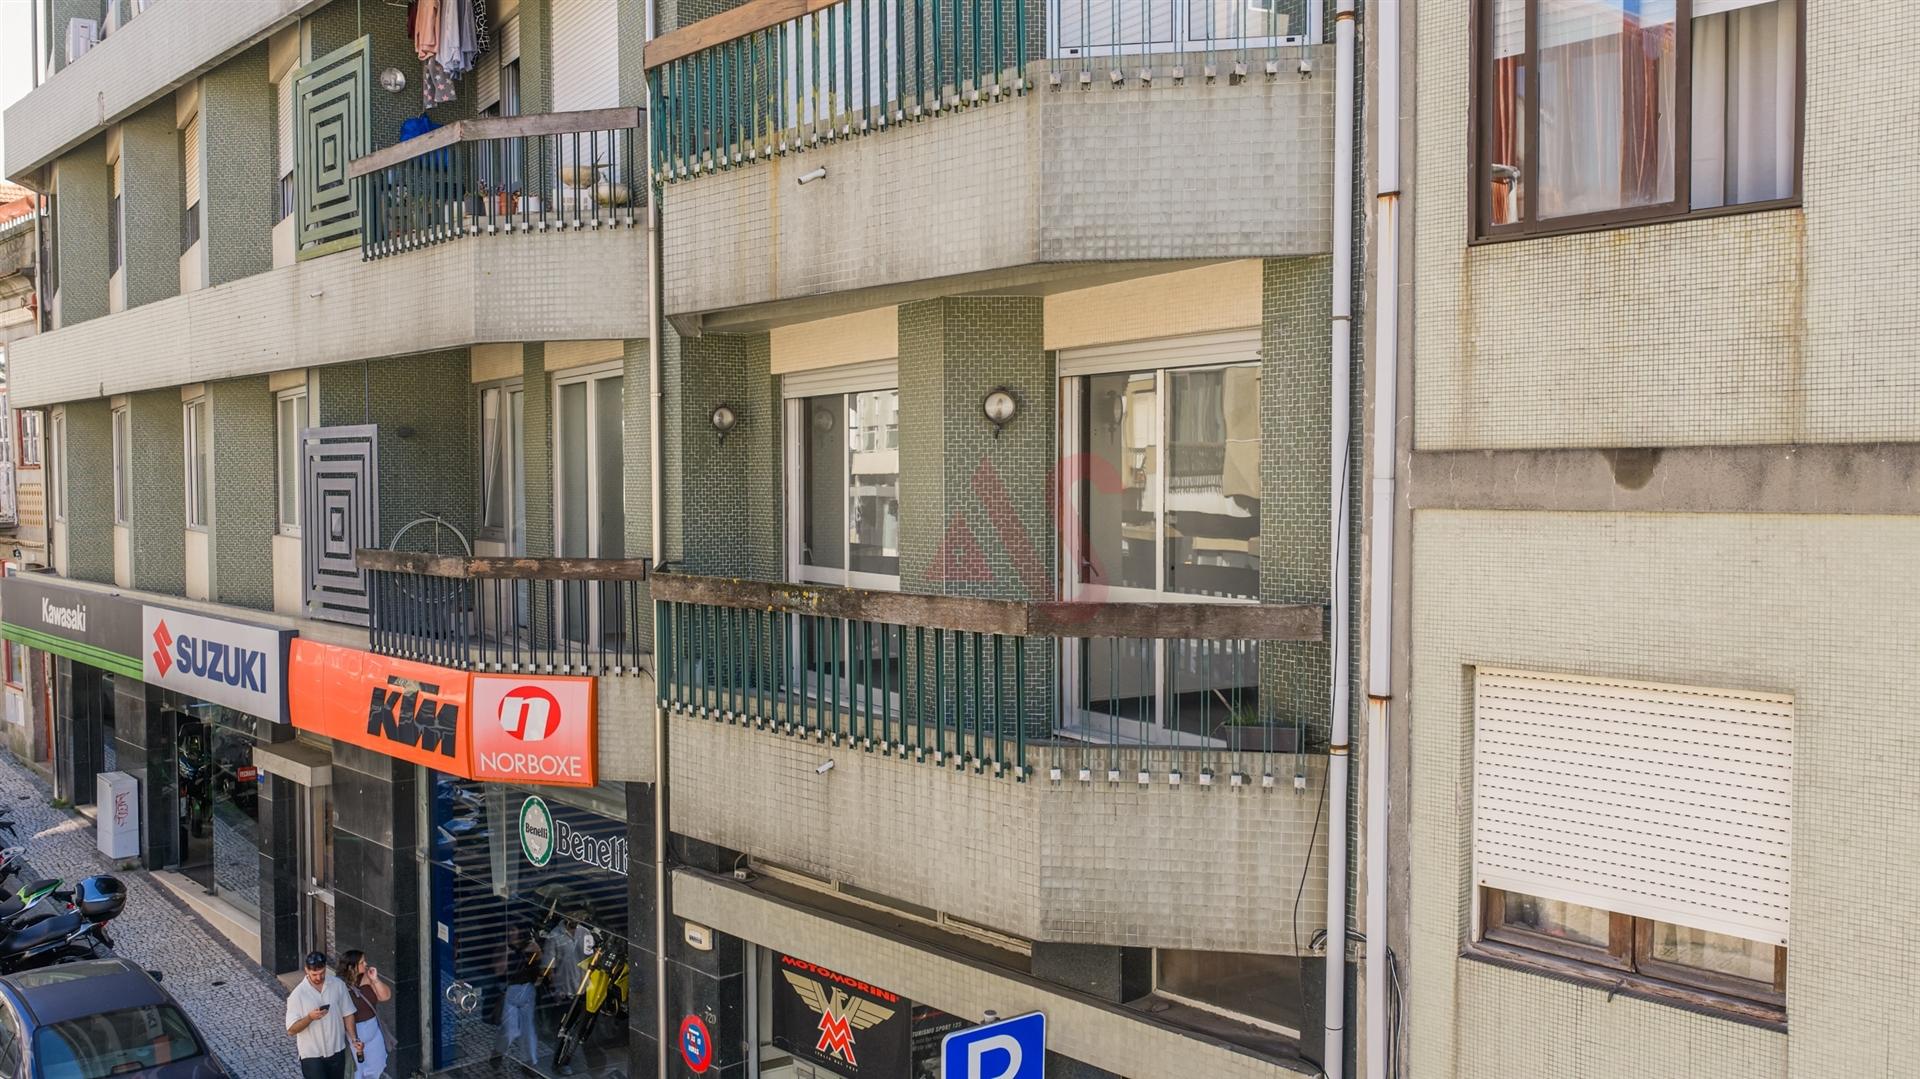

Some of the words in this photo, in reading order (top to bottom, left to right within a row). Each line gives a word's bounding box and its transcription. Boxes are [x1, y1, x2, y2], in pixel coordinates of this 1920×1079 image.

[42, 597, 87, 632] Kawasaki
[176, 634, 267, 694] SUZUKI
[367, 675, 459, 758] KTM
[480, 752, 582, 777] NORBOXE
[525, 822, 548, 840] Benelli
[556, 820, 628, 876] Benell
[912, 1027, 935, 1038] TURISMO
[935, 1023, 951, 1033] SPORT
[968, 1034, 1022, 1079] P
